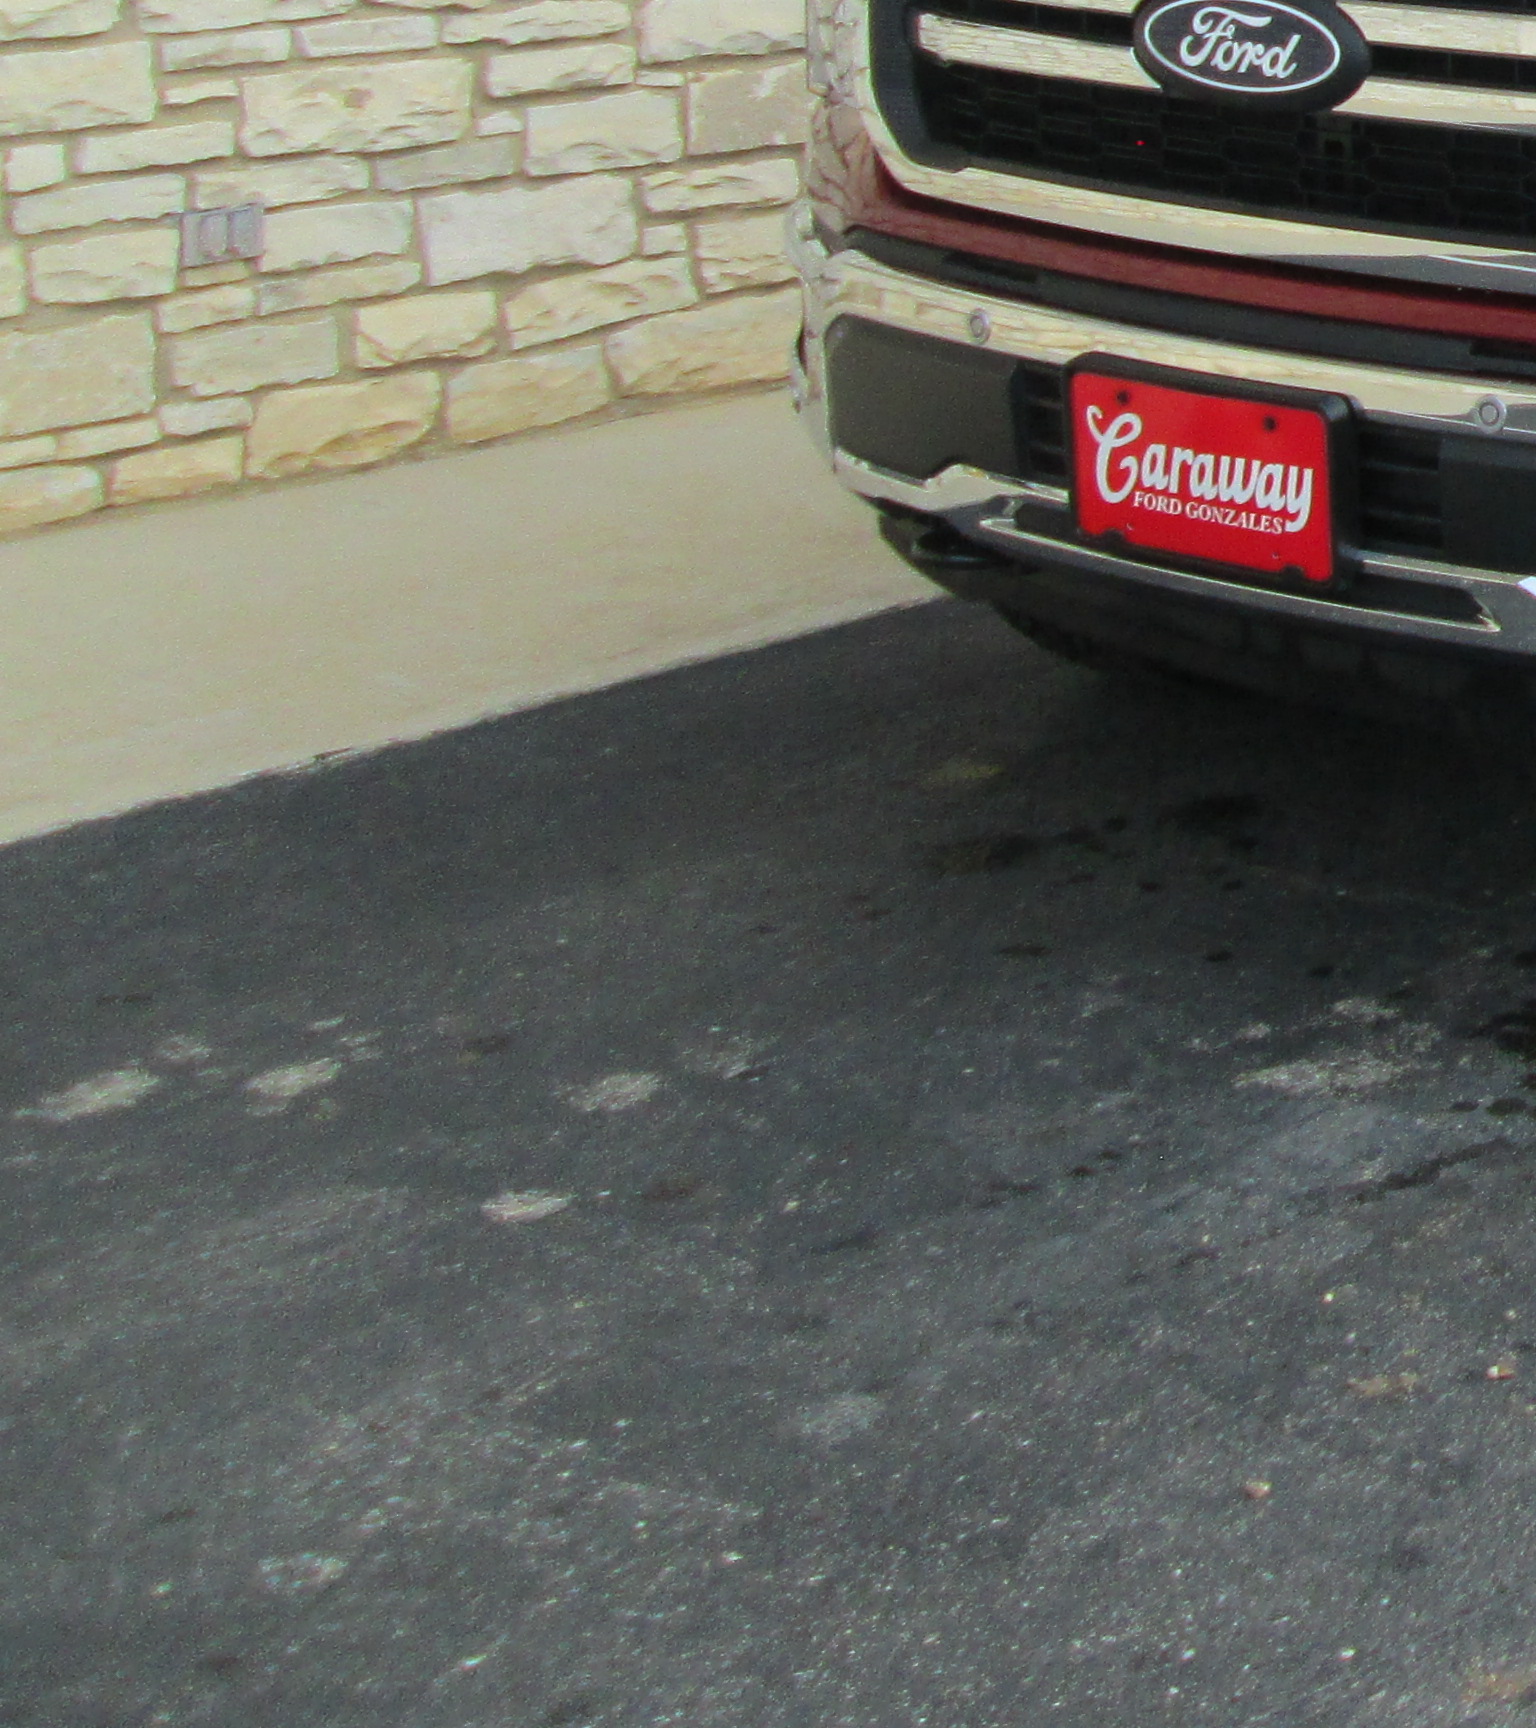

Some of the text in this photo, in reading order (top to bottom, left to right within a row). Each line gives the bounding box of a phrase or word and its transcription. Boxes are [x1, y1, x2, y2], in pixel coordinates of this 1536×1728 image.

[1179, 5, 1302, 79] Ford
[1086, 405, 1314, 533] Caraway
[1132, 490, 1284, 534] FORD GONZALES
